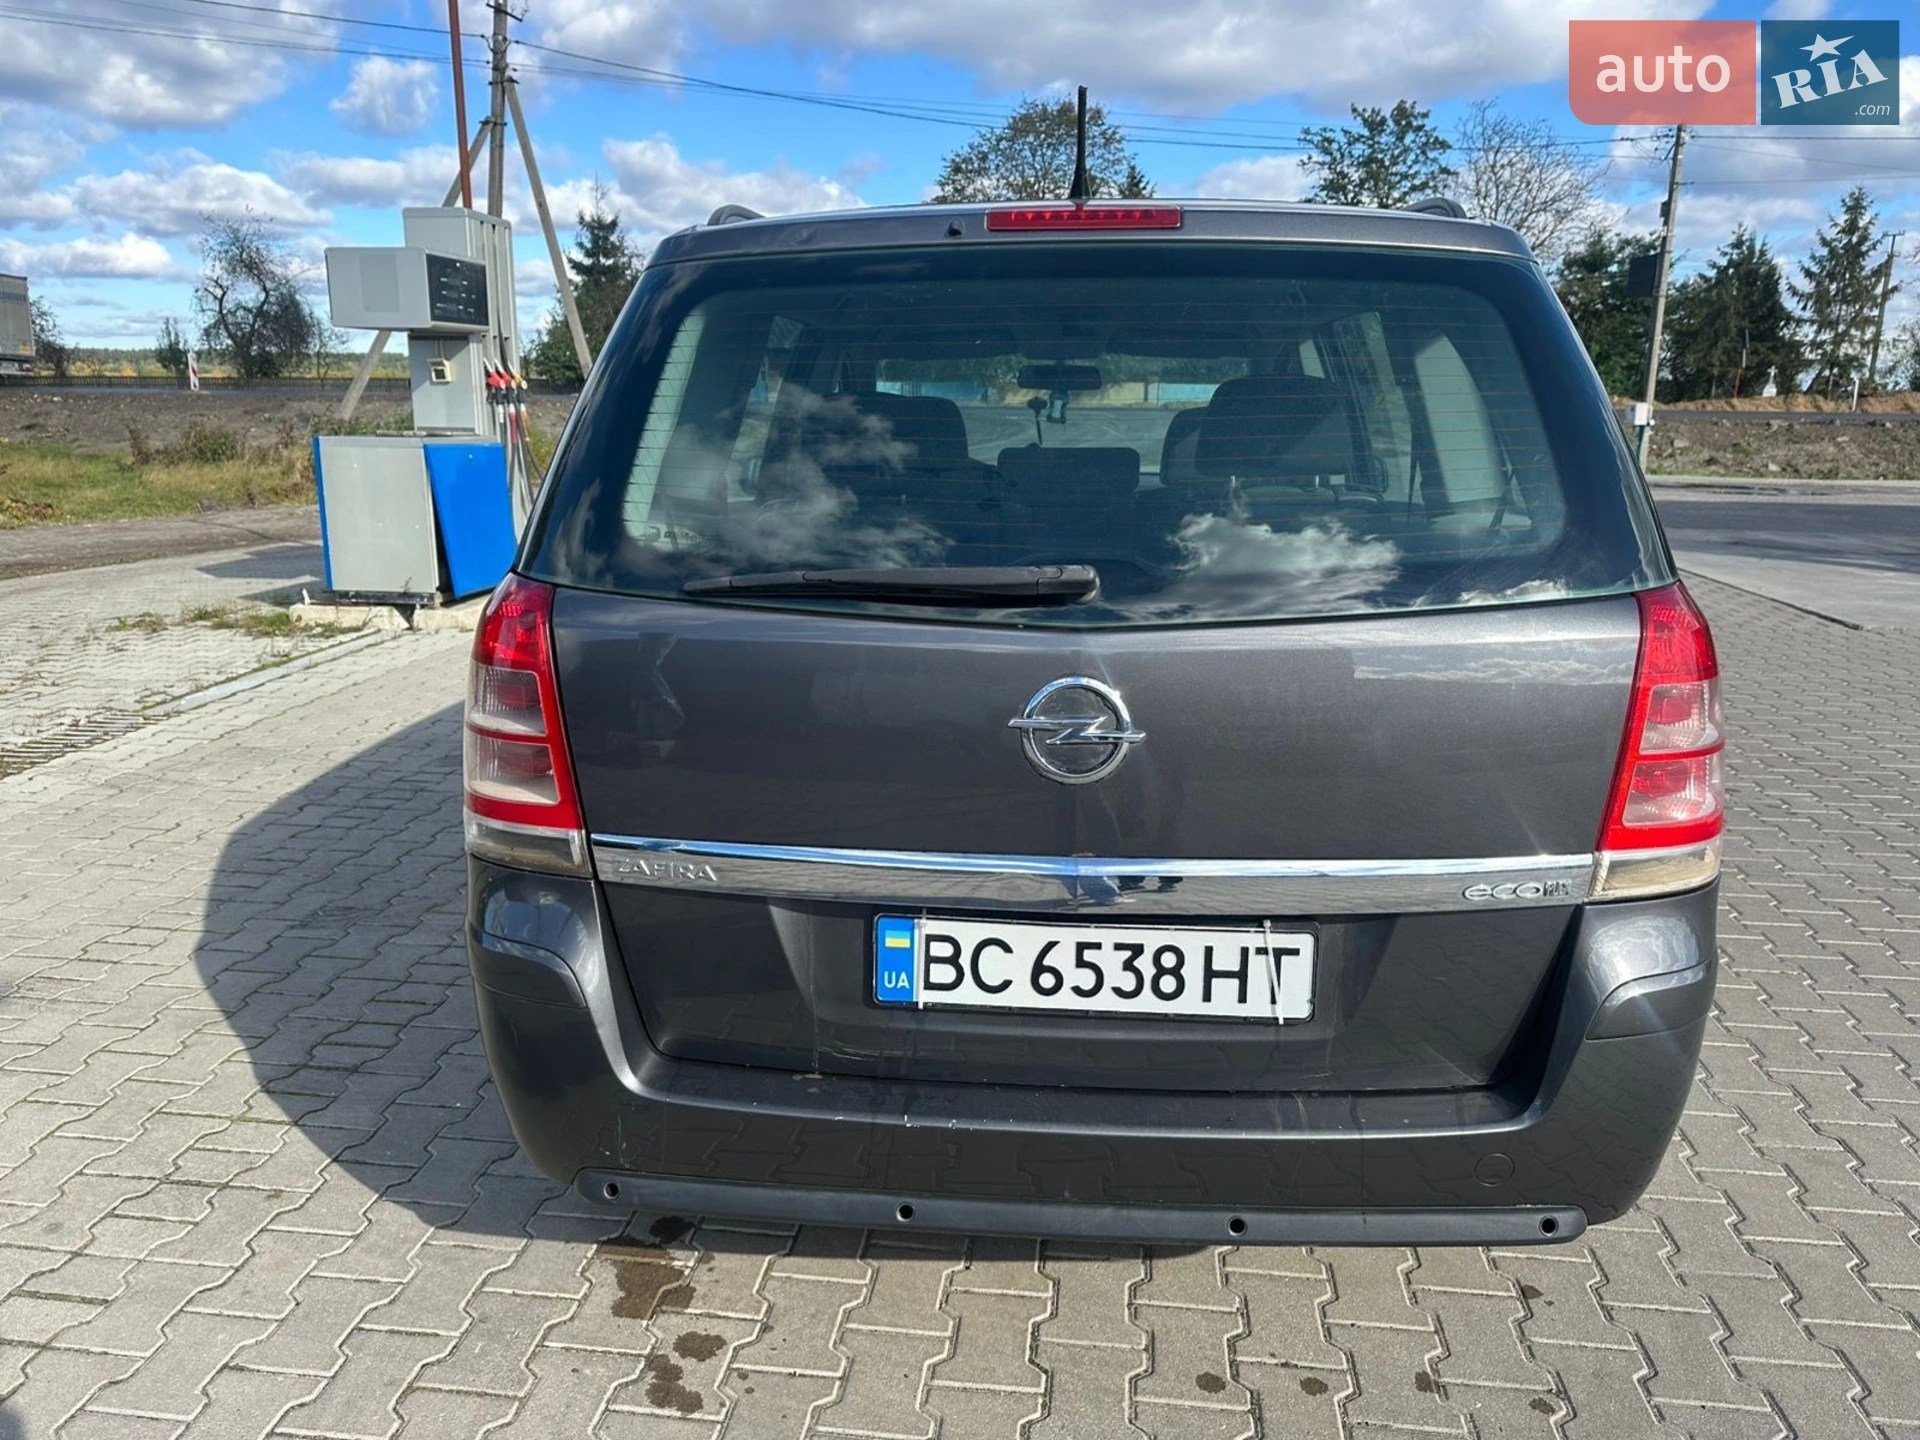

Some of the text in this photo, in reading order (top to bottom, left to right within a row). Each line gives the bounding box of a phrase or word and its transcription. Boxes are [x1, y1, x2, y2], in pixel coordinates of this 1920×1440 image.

[616, 857, 718, 881] ZAFIRA
[884, 971, 910, 989] UA
[923, 934, 1300, 1004] BC 6538 HT
